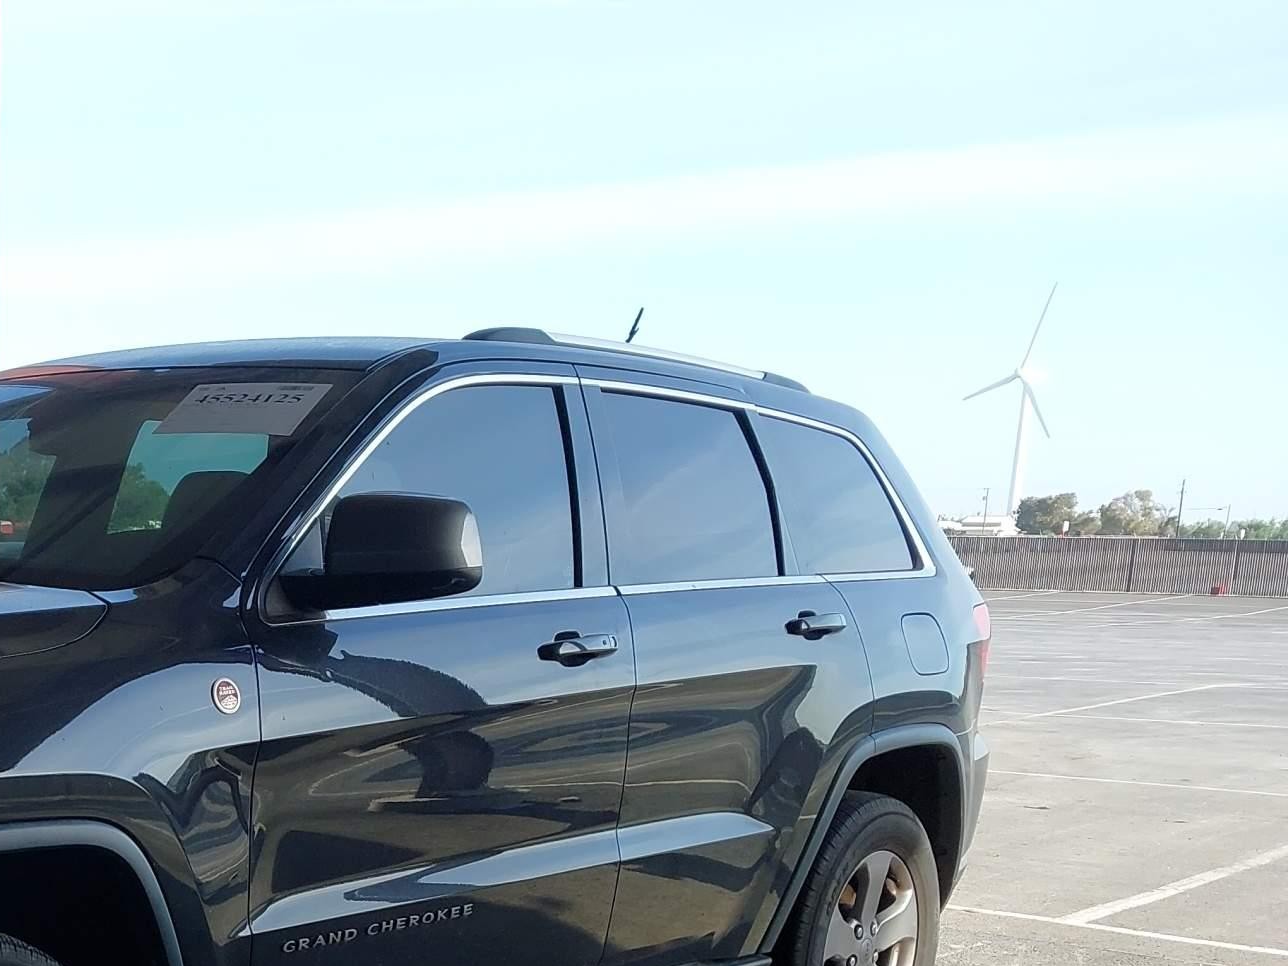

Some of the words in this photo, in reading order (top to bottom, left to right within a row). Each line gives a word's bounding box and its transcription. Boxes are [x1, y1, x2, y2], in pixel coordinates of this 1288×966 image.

[195, 393, 305, 403] 45524125
[283, 928, 357, 953] GRAND
[367, 903, 474, 936] CHEROKEE
